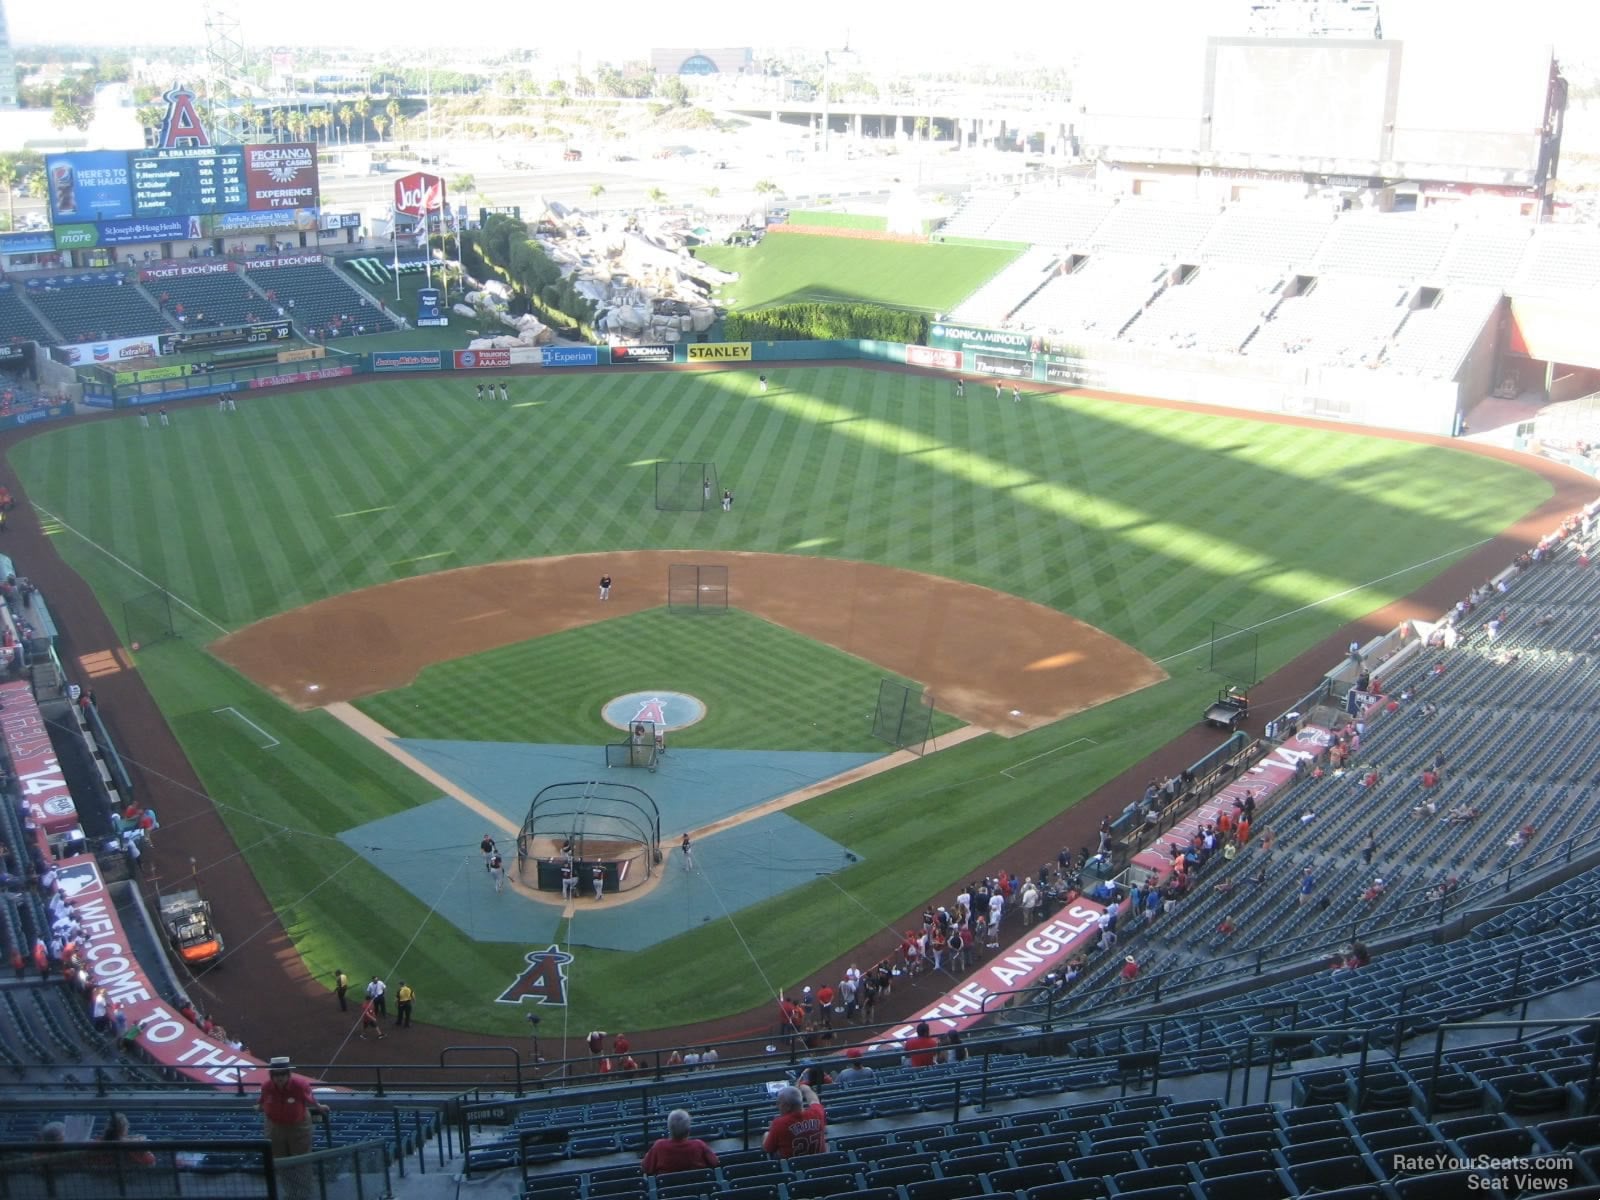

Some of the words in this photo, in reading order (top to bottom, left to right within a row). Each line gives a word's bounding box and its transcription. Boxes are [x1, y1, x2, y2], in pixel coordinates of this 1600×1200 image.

[169, 149, 184, 157] ERA
[184, 148, 217, 156] LEADERS
[251, 148, 312, 161] PECHANGA
[251, 160, 279, 169] RESORT
[77, 169, 111, 179] HERE'S
[113, 168, 127, 177] TO
[79, 178, 96, 187] THE
[97, 176, 128, 186] HALOS
[255, 187, 313, 199] EXPERIENCE
[270, 199, 279, 207] IT
[281, 198, 299, 206] ALL
[160, 221, 182, 230] Health
[62, 232, 92, 243] more
[246, 259, 276, 269] TICKET
[146, 267, 179, 278] TICKET
[277, 327, 289, 337] yp
[945, 328, 983, 341] KONICA
[984, 331, 1028, 347] MINOLTA
[554, 352, 592, 362] Experian
[627, 347, 671, 356] YOKOHAMA
[689, 346, 750, 358] STANLEY
[990, 905, 1101, 987] ANGELS
[77, 898, 152, 1006] WELCOME
[920, 982, 997, 1028] THE
[139, 1006, 185, 1043] TO
[176, 1038, 257, 1084] THE
